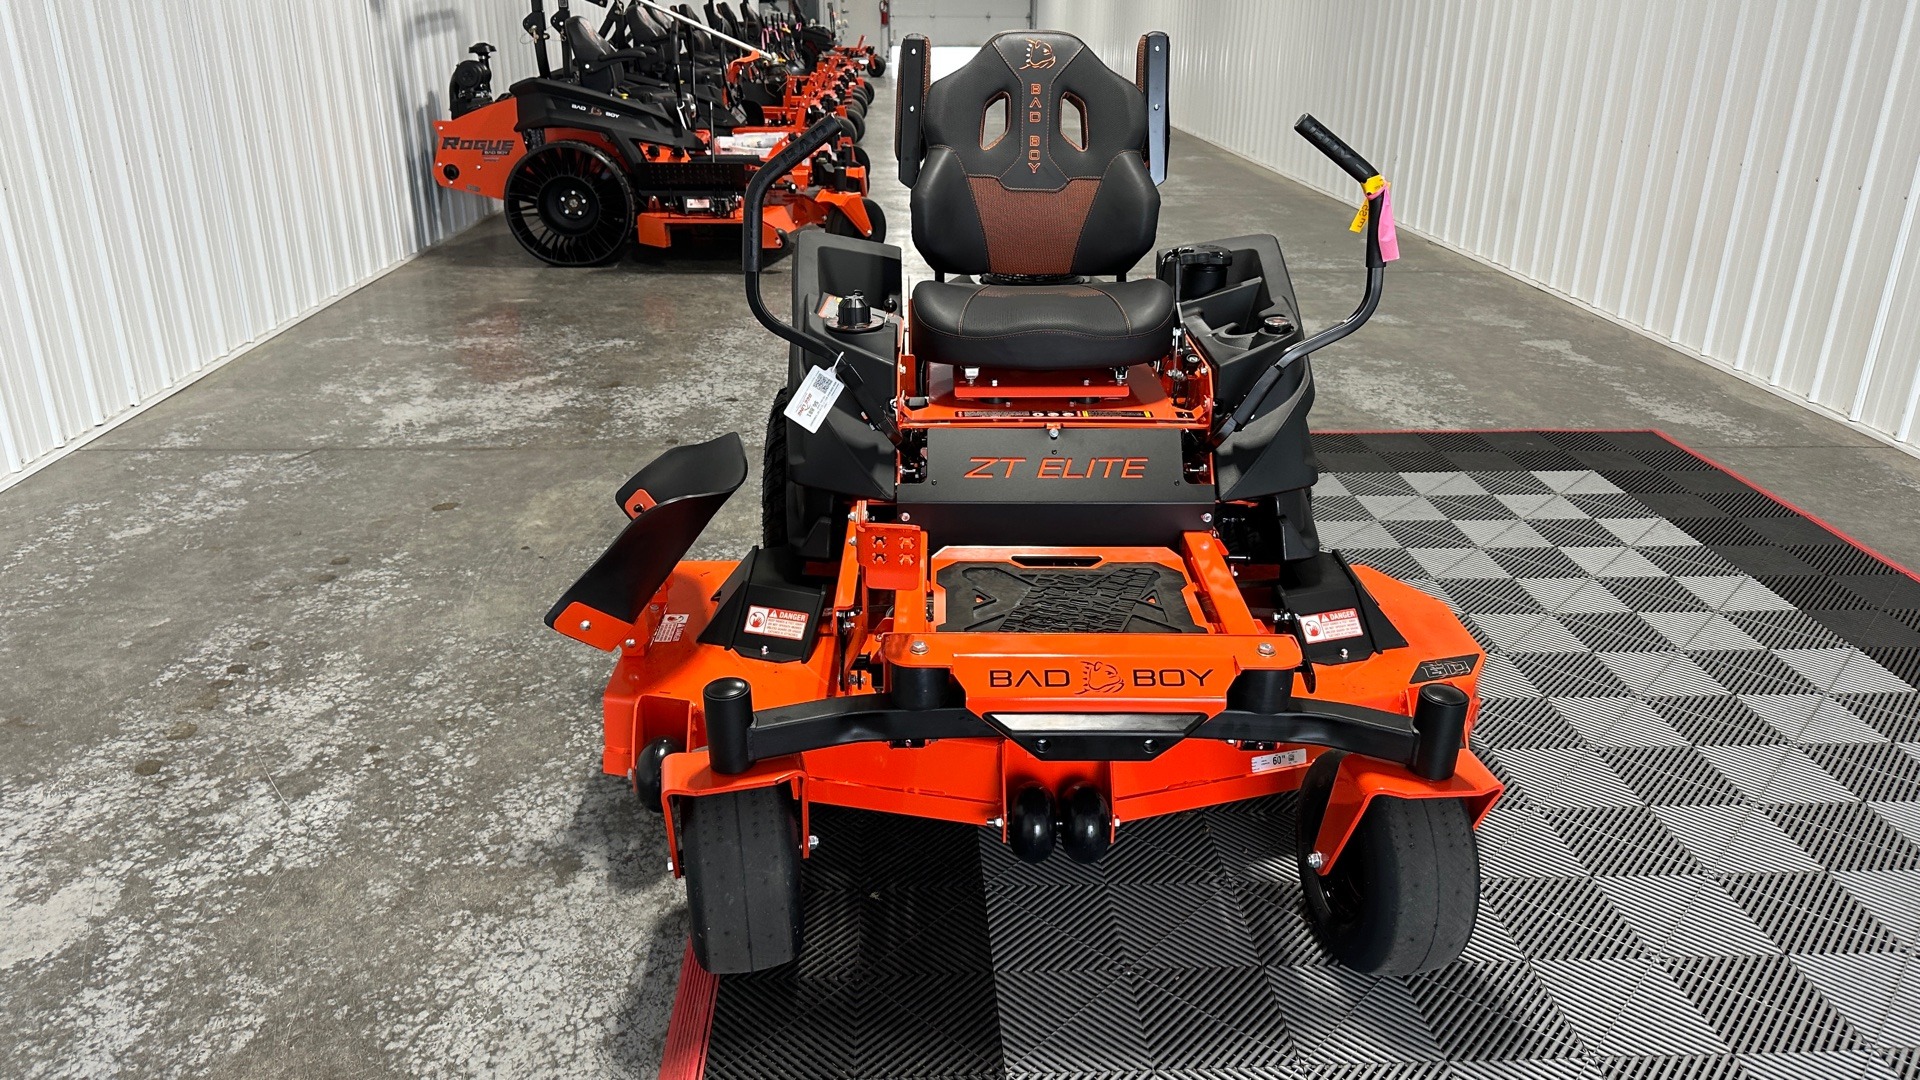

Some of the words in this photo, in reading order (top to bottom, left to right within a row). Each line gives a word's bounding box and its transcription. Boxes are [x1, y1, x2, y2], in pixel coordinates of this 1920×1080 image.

[571, 103, 587, 111] BAD
[605, 111, 620, 119] BOY
[1029, 83, 1042, 123] BAD
[1028, 135, 1043, 174] BOY
[963, 456, 1026, 479] ZT
[1037, 456, 1149, 479] ELITE
[778, 611, 807, 622] DANGER
[1329, 609, 1356, 620] DANGER
[989, 669, 1070, 688] BAD
[1132, 668, 1214, 687] BOY
